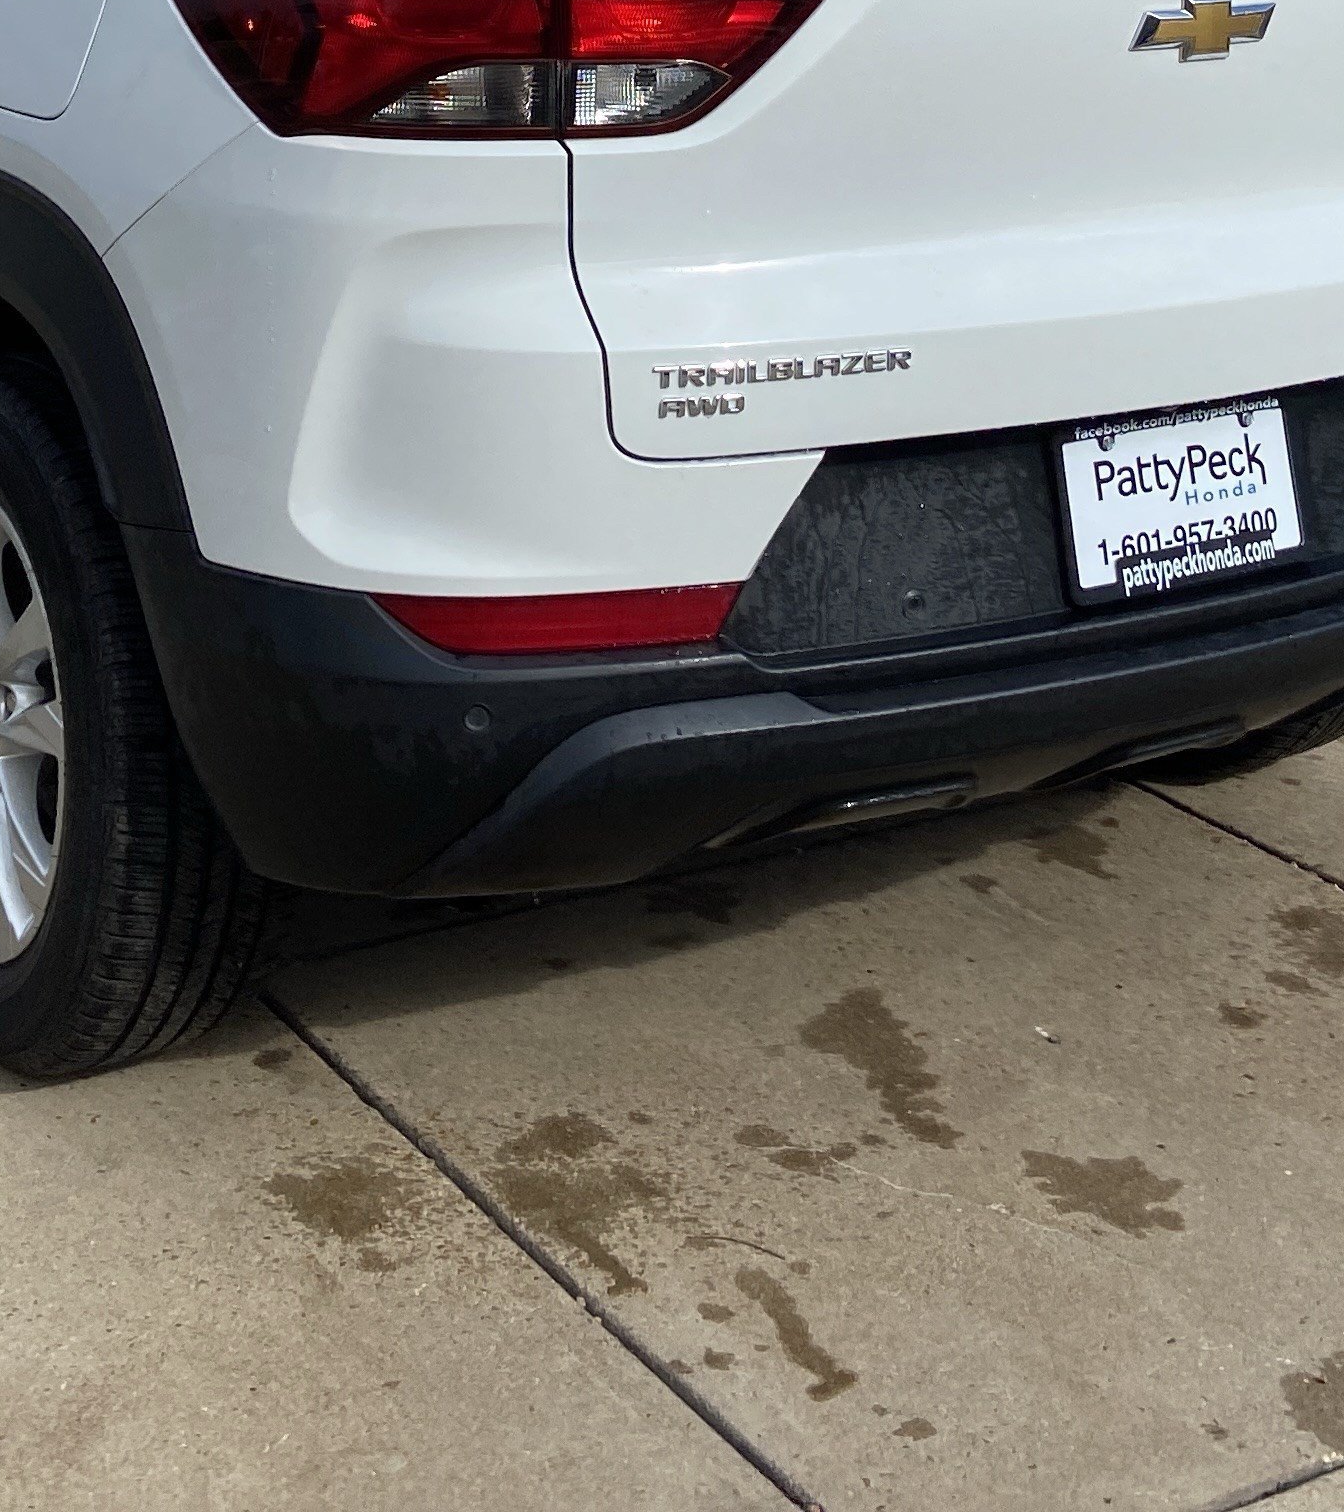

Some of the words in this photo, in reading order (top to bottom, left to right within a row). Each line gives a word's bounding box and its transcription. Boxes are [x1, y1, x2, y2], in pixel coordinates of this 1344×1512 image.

[652, 348, 912, 389] TRAILBLAZER
[658, 392, 745, 419] AWD
[1074, 397, 1280, 440] facebook.com/pattypeckhonda
[1093, 433, 1267, 502] PattyPeck
[1185, 480, 1257, 506] Honda
[1097, 508, 1277, 565] 1-601-957-3400
[1122, 536, 1275, 596] pattypeckhonda.com
